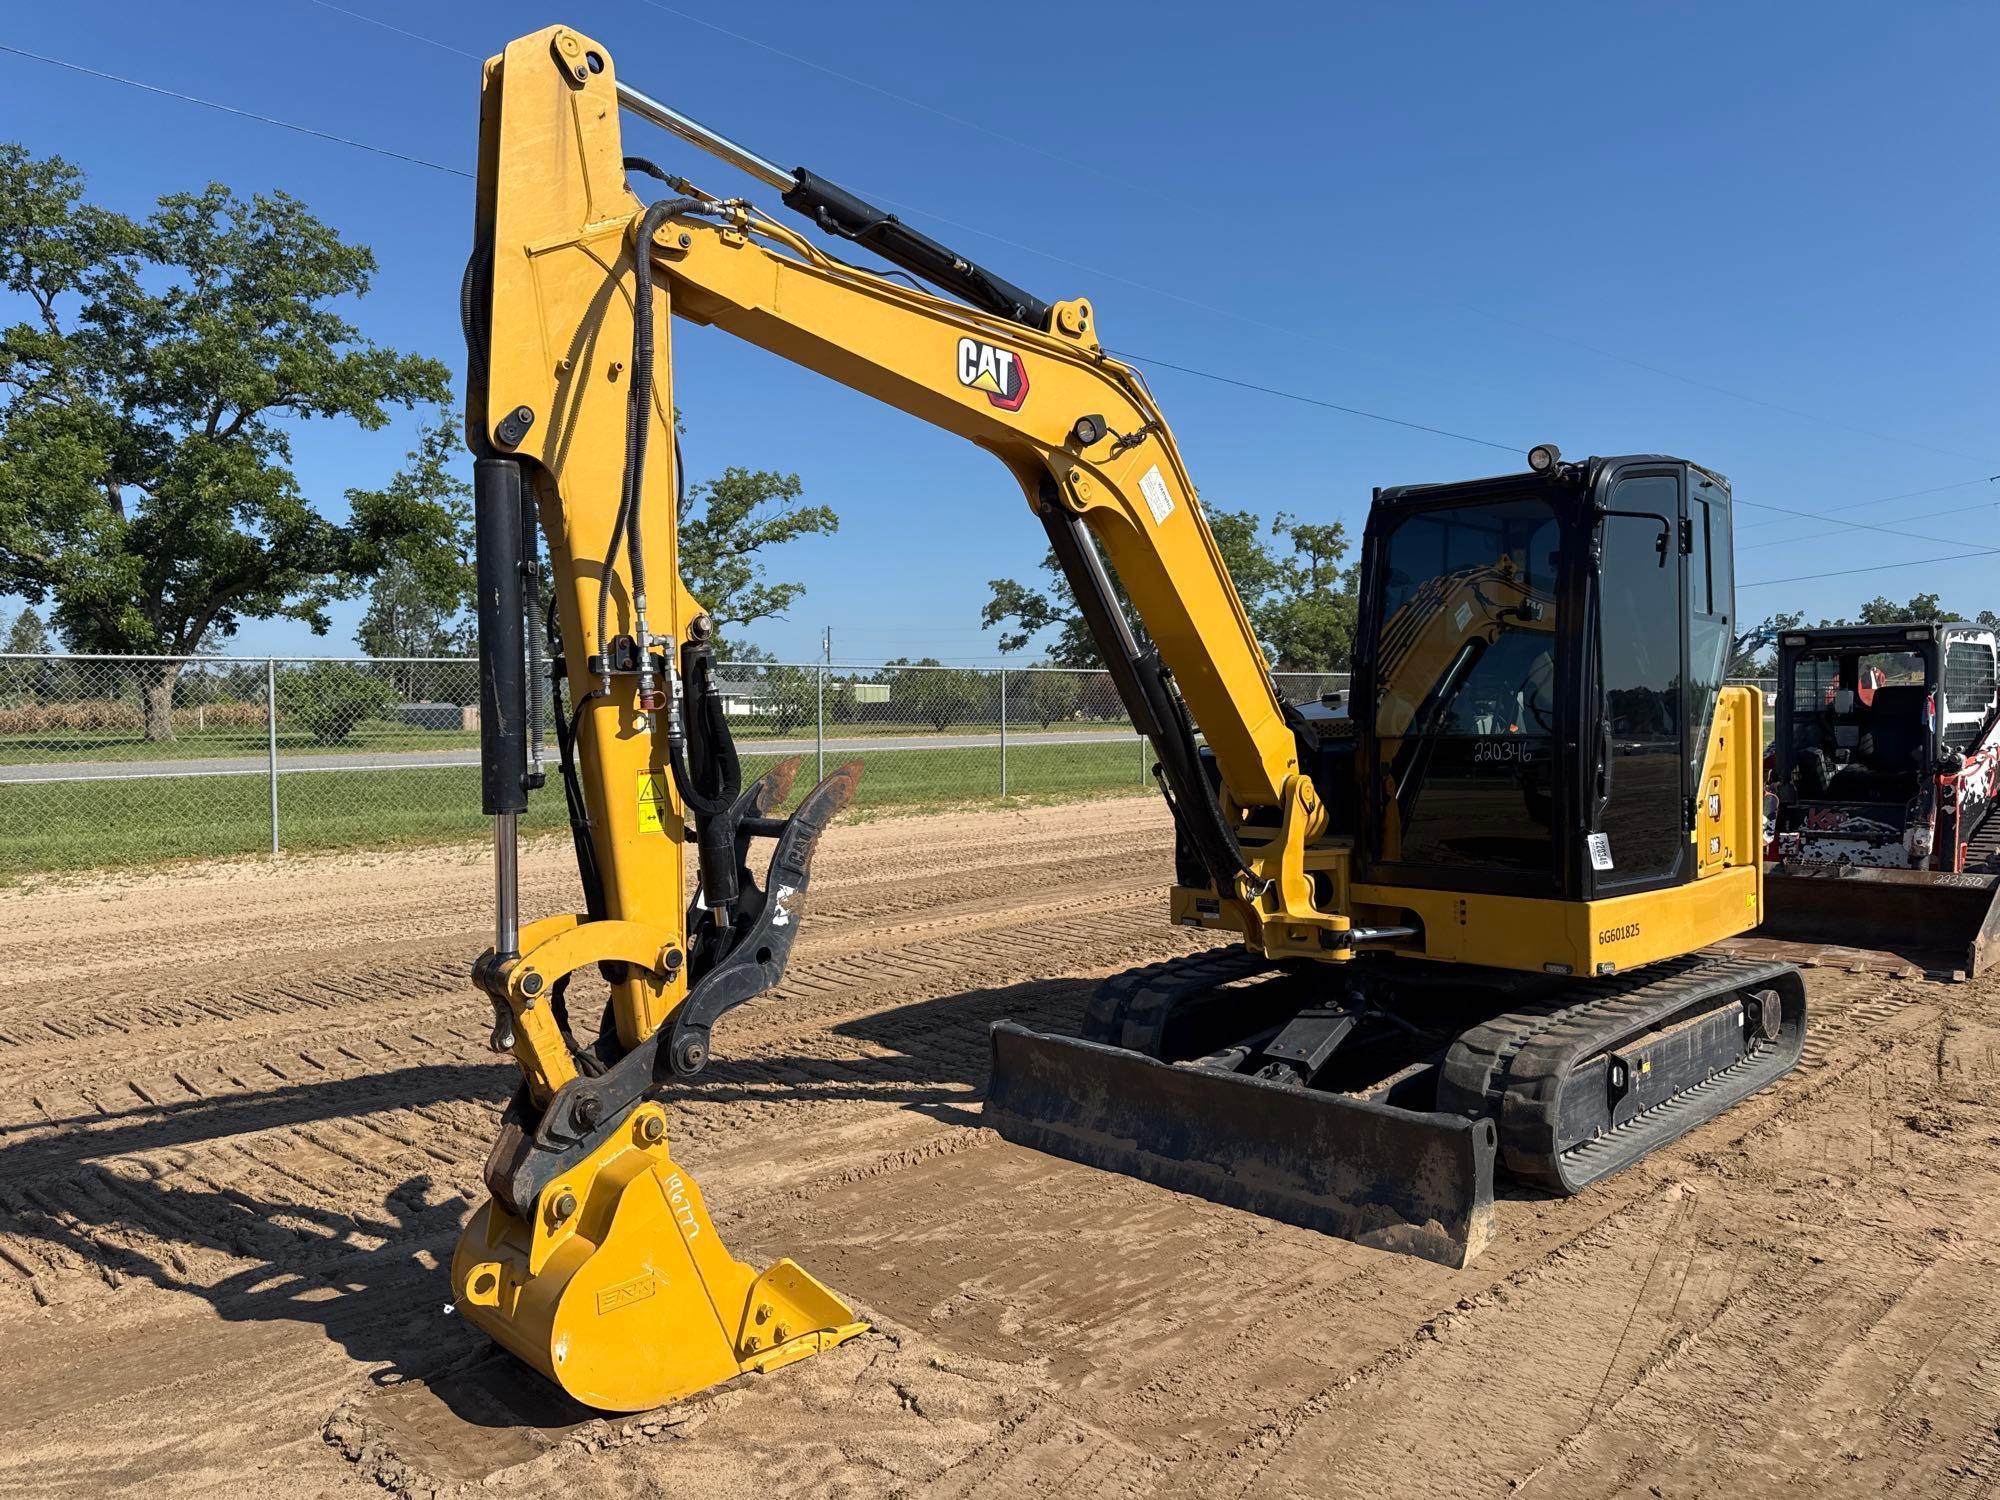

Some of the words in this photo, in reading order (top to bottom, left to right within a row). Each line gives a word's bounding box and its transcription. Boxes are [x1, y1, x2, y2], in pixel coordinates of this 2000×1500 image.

[959, 338, 1013, 395] CAT
[1474, 741, 1532, 762] 220346
[788, 829, 812, 867] CAT
[1599, 923, 1640, 945] 6G601825
